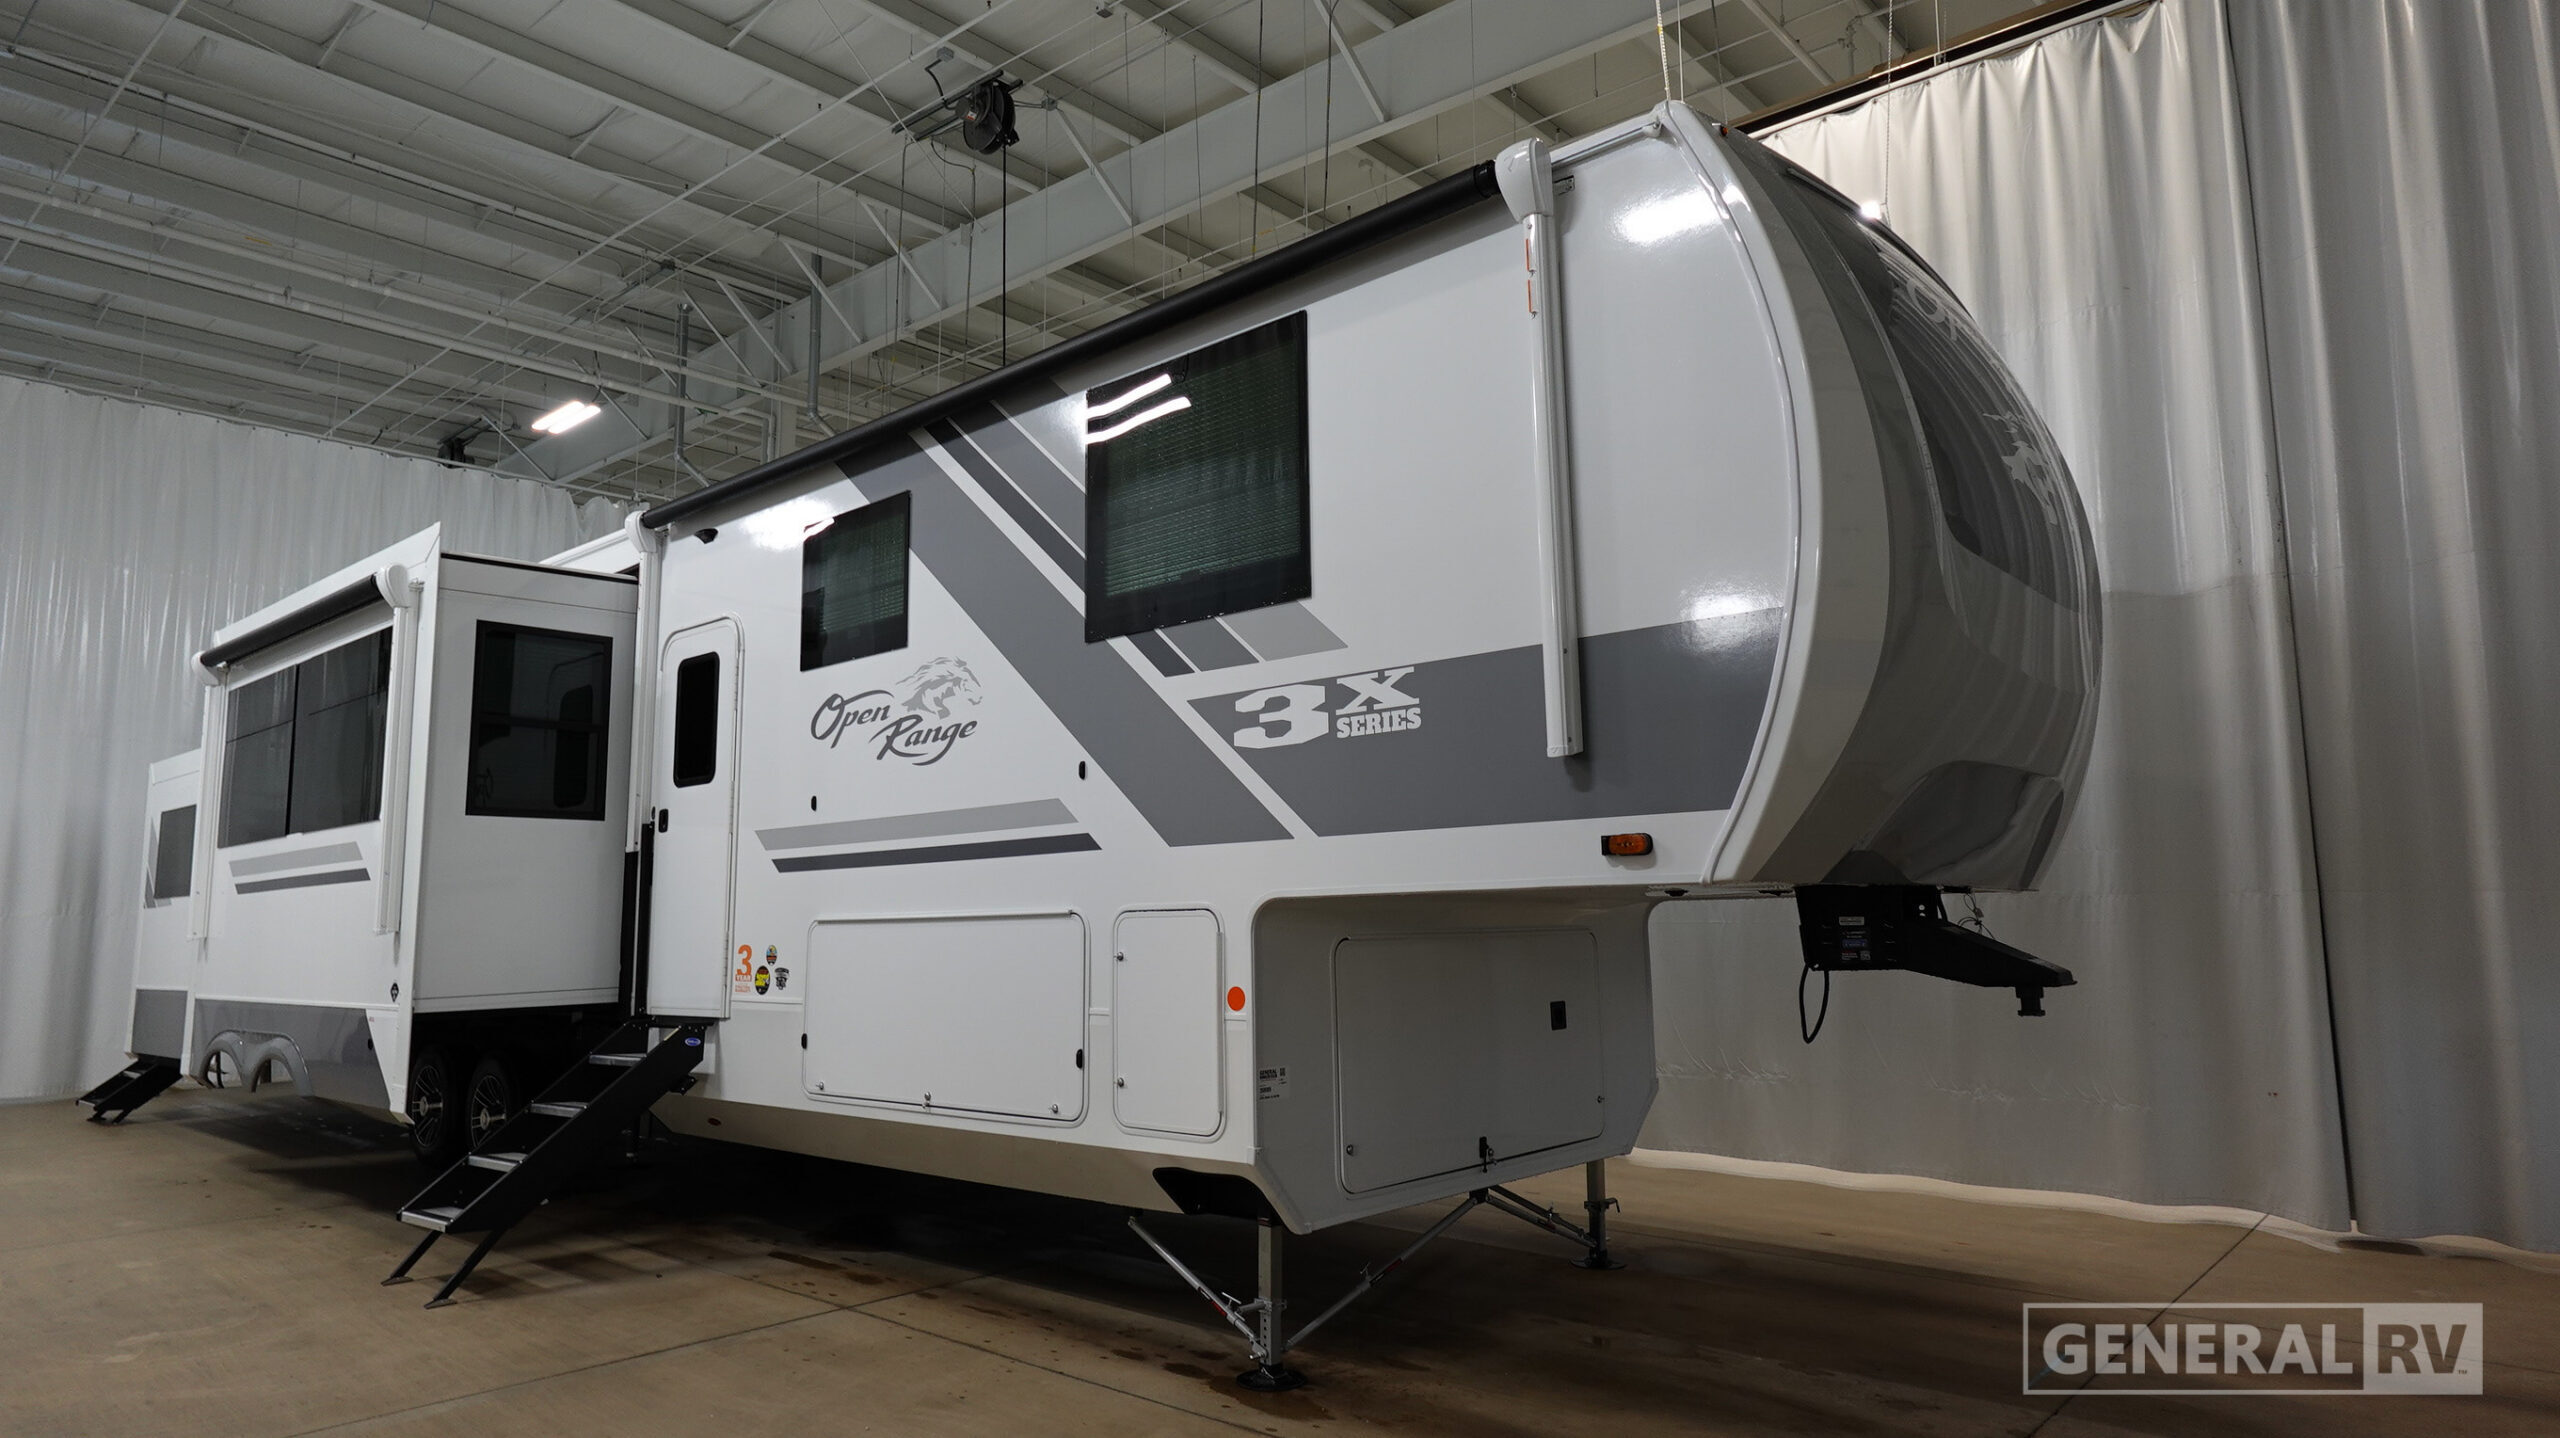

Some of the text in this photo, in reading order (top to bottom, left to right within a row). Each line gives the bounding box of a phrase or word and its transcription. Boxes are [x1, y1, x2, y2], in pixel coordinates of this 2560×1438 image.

[810, 689, 895, 748] Open
[868, 711, 978, 766] Range
[1335, 707, 1422, 739] SERIES
[736, 944, 752, 976] 3
